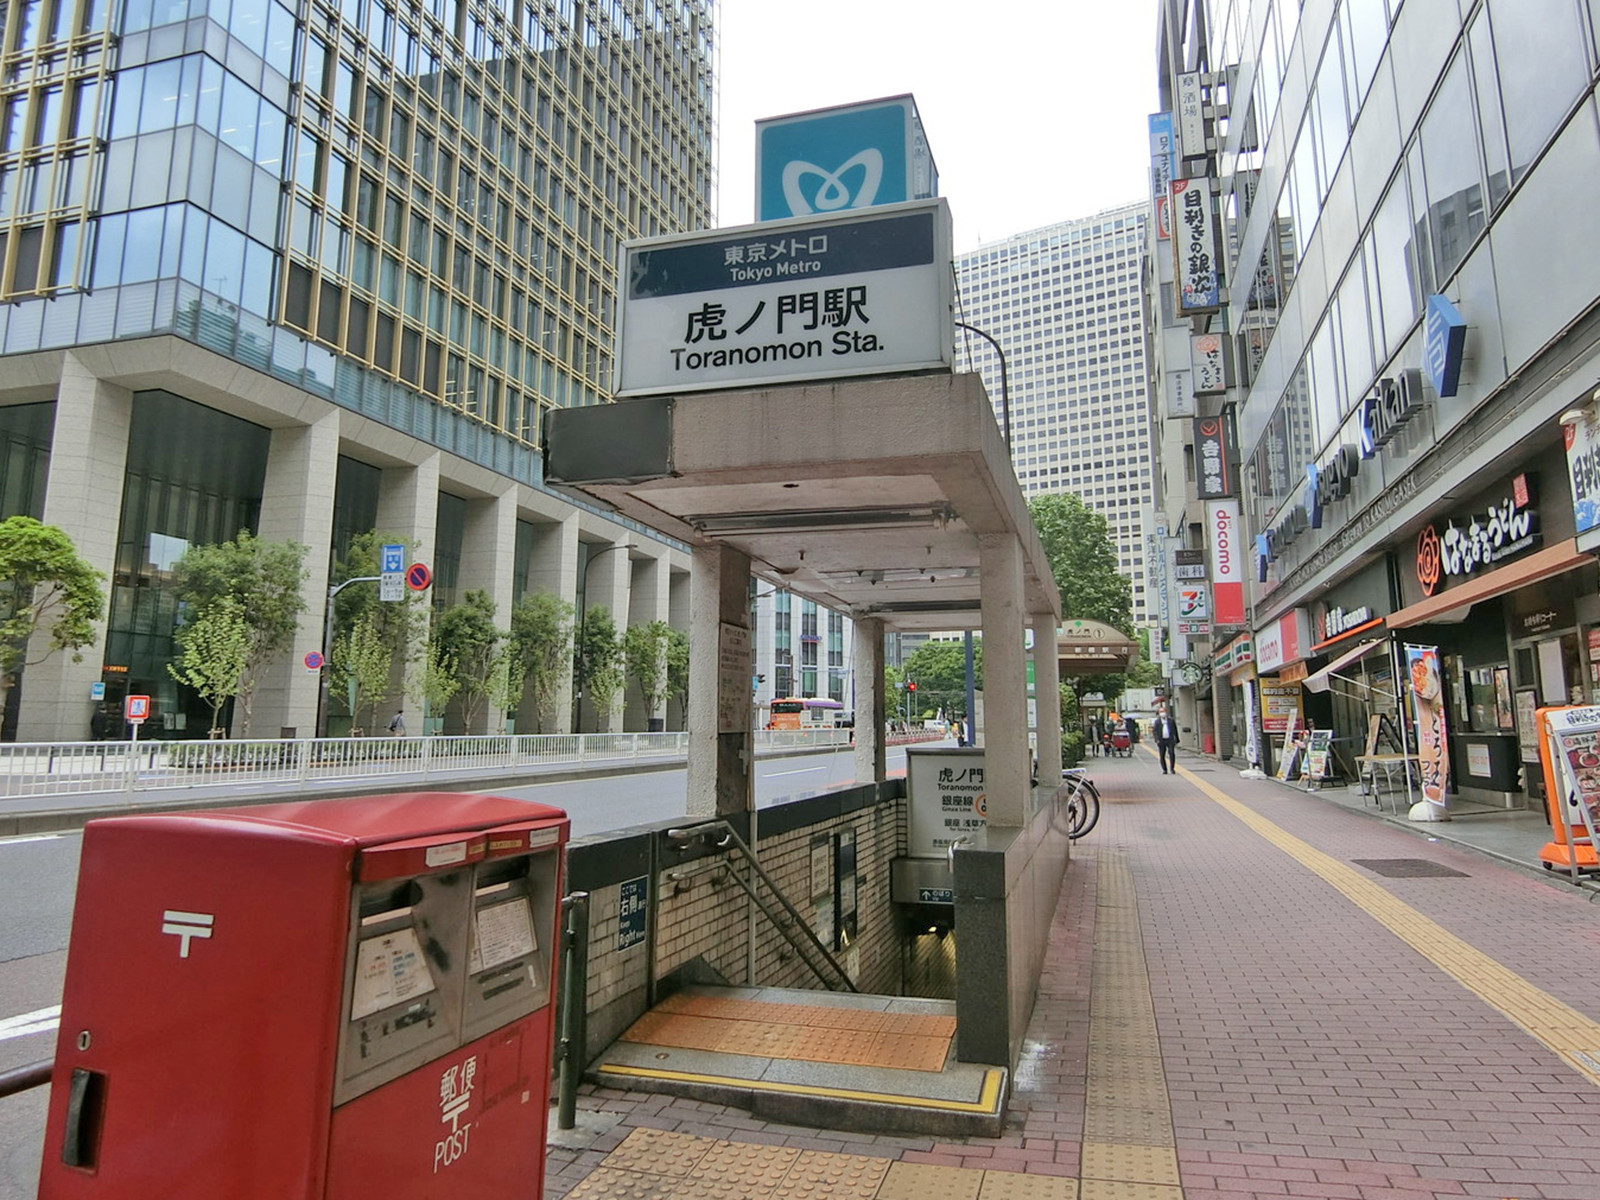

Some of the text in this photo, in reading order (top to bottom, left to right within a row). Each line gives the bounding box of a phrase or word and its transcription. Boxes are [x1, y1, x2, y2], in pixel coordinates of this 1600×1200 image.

[724, 234, 828, 266] 東京メトロ
[1184, 189, 1211, 294] 目利きの銀次
[730, 259, 821, 282] Tokyo Metro
[684, 285, 870, 344] 虎ノ門駅
[670, 330, 885, 371] Toranomon Sta.
[1207, 349, 1221, 383] はなまる
[1201, 367, 1214, 389] うどん
[1357, 367, 1418, 460] Kaikan
[1202, 439, 1222, 494] 吉野家
[1216, 510, 1231, 575] docomo
[1440, 497, 1530, 575] はなまるうどん
[1179, 566, 1202, 577] 歯科
[1325, 606, 1343, 638] 吉野家
[937, 783, 984, 791] Toranomon
[938, 767, 984, 783] 虎ノ門
[942, 795, 973, 806] 銀座線
[944, 818, 960, 827] 銀座
[439, 1055, 477, 1107] 郵便
[434, 1123, 471, 1174] POST
